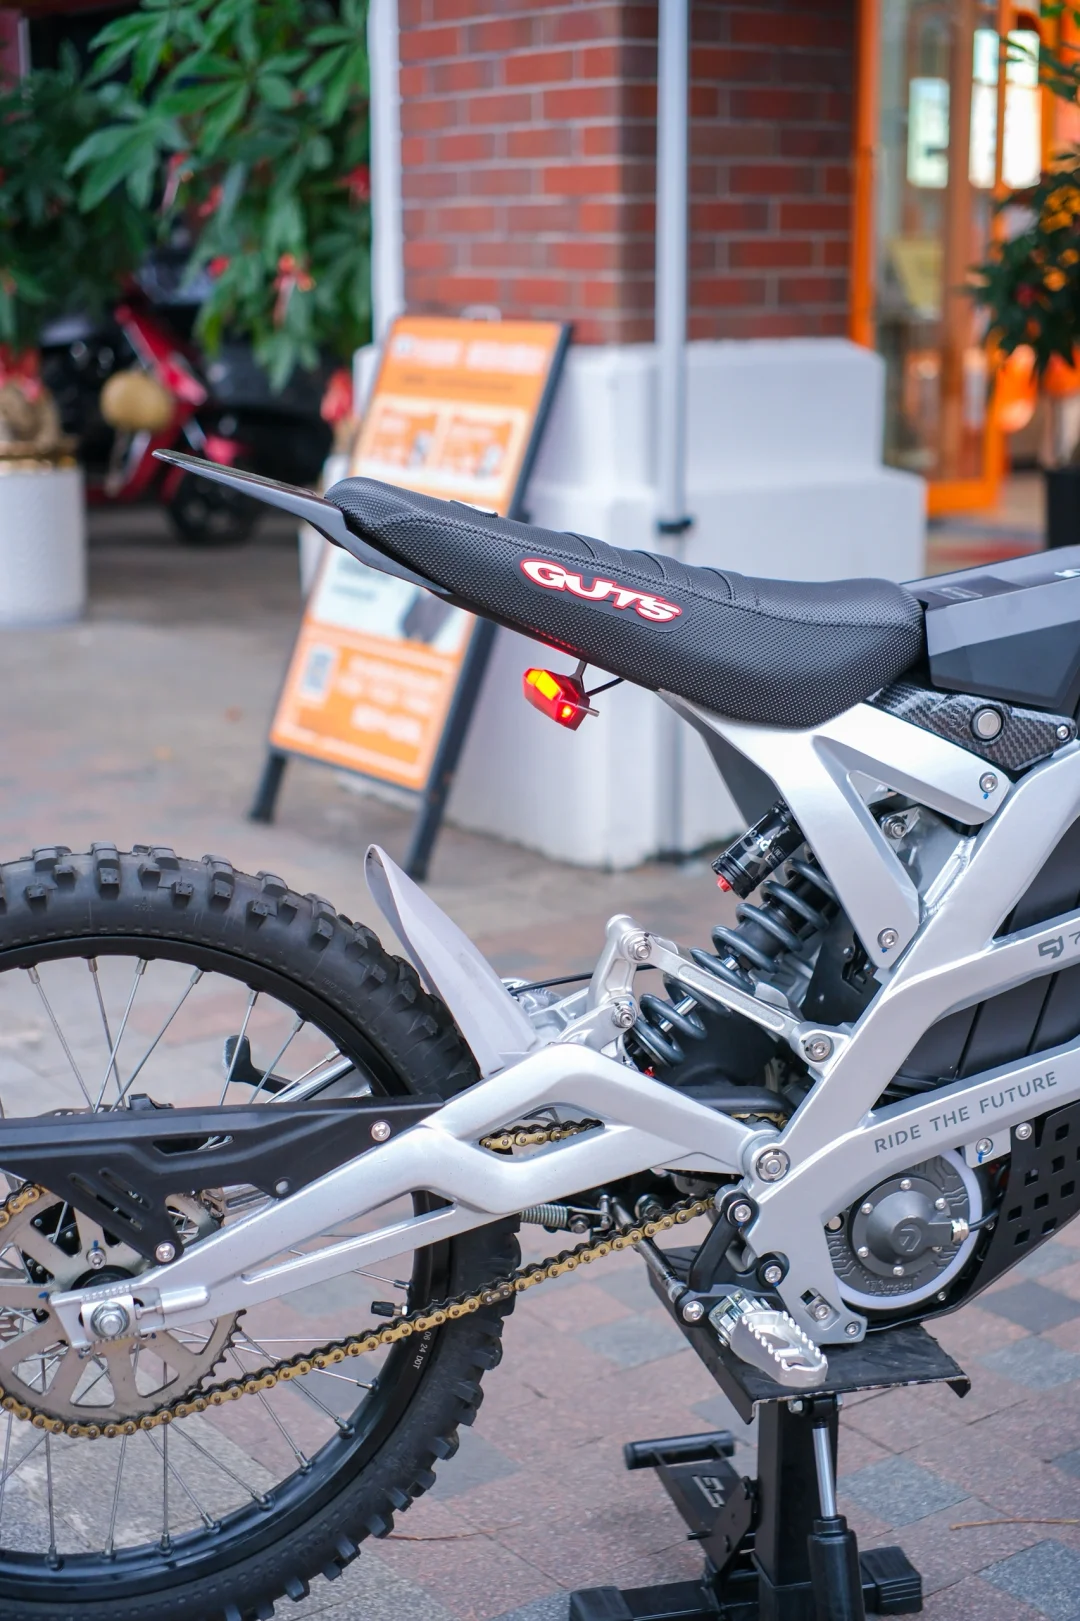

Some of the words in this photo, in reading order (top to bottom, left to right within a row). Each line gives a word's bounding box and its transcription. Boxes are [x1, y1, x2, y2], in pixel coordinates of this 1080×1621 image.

[520, 558, 682, 622] GUTS
[874, 1124, 922, 1153] RIDE
[929, 1105, 970, 1132] THE
[979, 1070, 1058, 1114] FUTURE
[413, 1355, 424, 1369] DOT
[419, 1343, 428, 1353] 24
